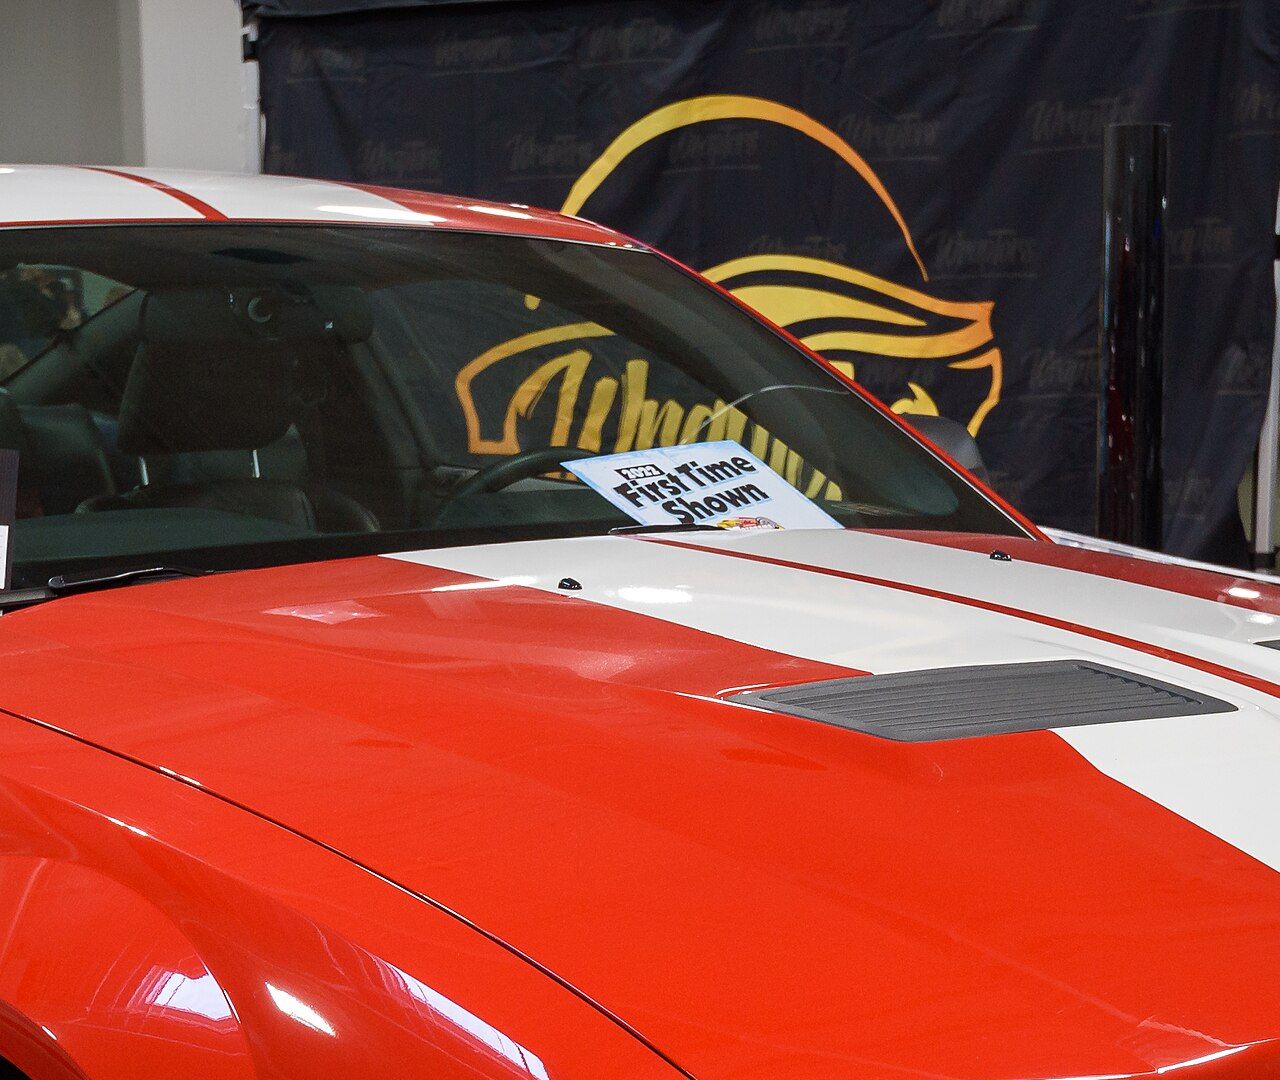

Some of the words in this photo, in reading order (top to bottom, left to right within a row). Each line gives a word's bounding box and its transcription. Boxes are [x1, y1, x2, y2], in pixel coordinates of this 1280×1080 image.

[613, 472, 692, 508] First
[673, 456, 757, 488] Time
[621, 464, 661, 479] 2022
[661, 483, 770, 525] Shown
